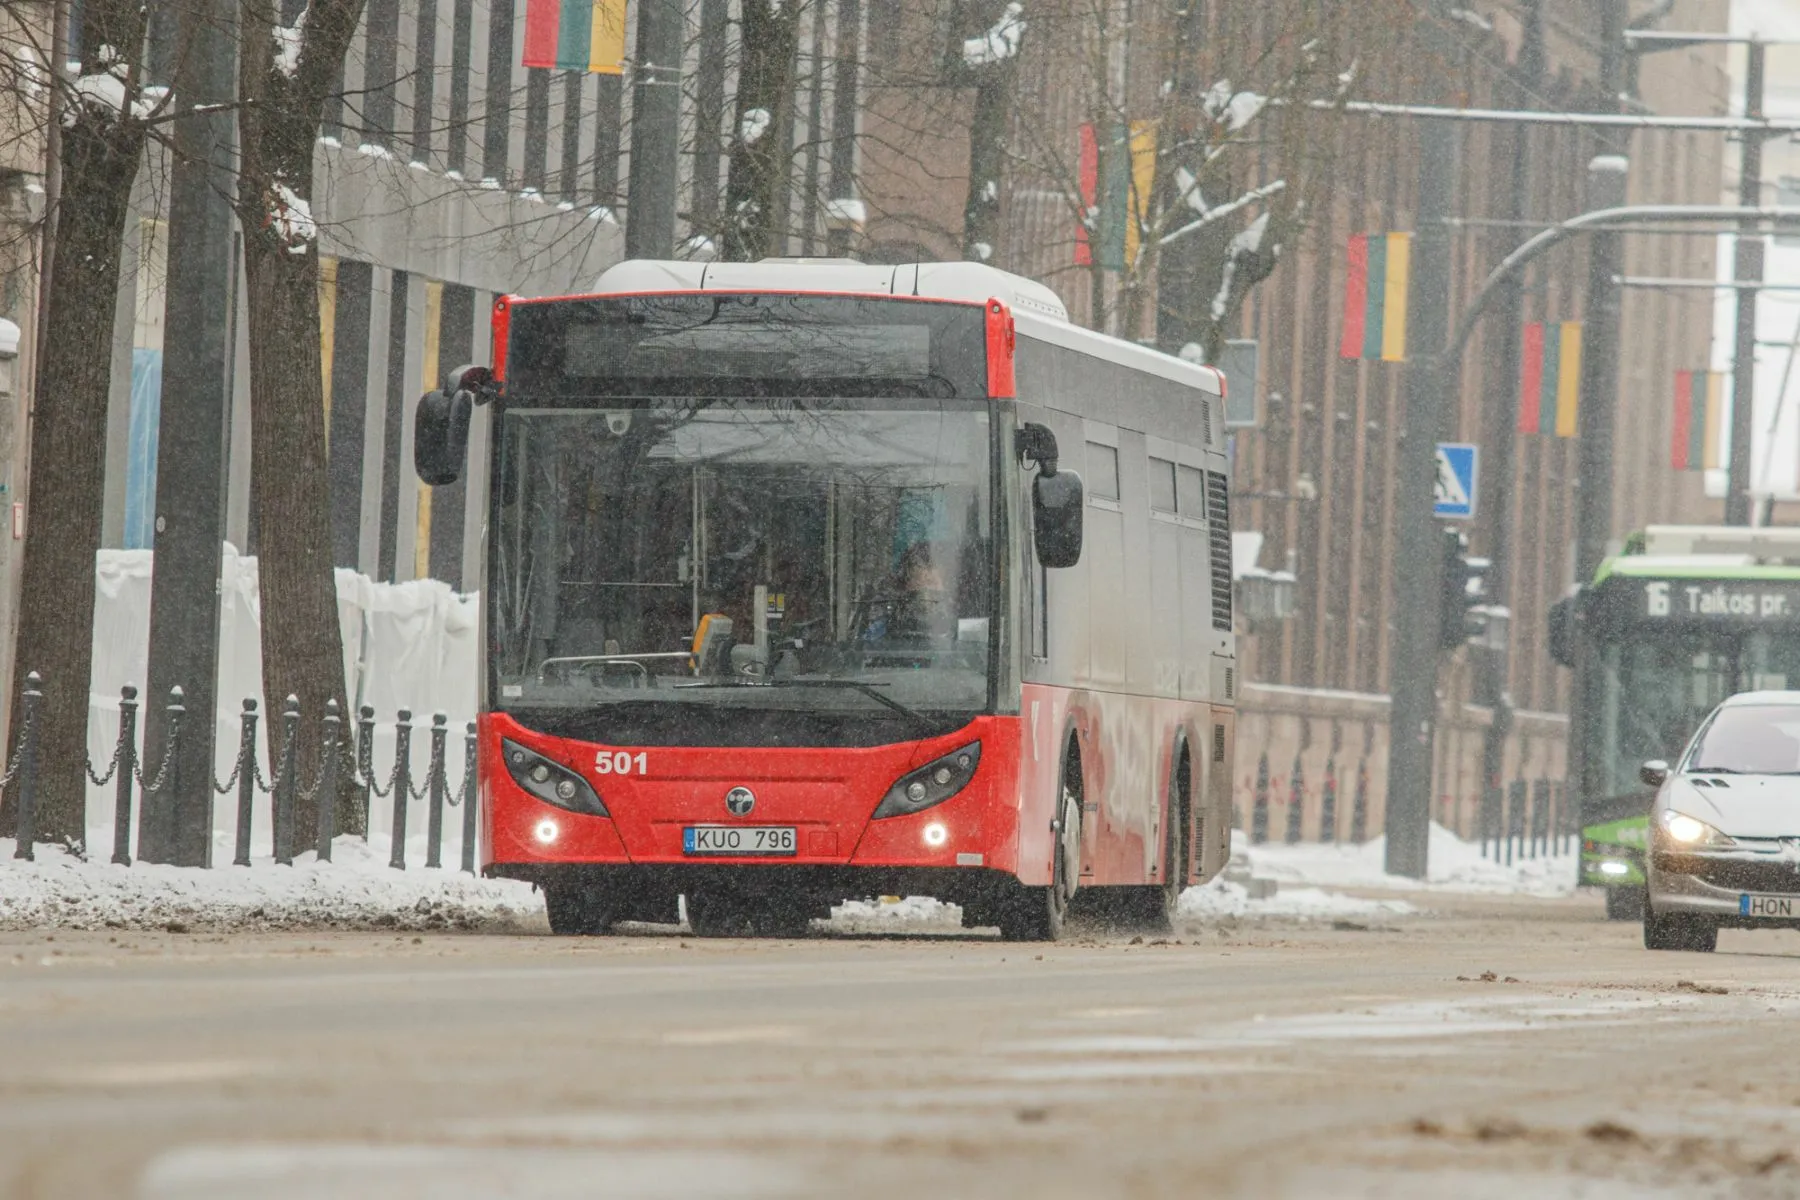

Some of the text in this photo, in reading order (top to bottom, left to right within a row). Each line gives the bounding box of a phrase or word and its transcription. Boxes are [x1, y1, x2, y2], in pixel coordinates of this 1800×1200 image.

[1645, 581, 1791, 618] 16 Taikos pr.
[594, 751, 647, 775] 501
[697, 831, 740, 848] KUO
[755, 831, 792, 848] 796
[1752, 898, 1791, 915] HON
